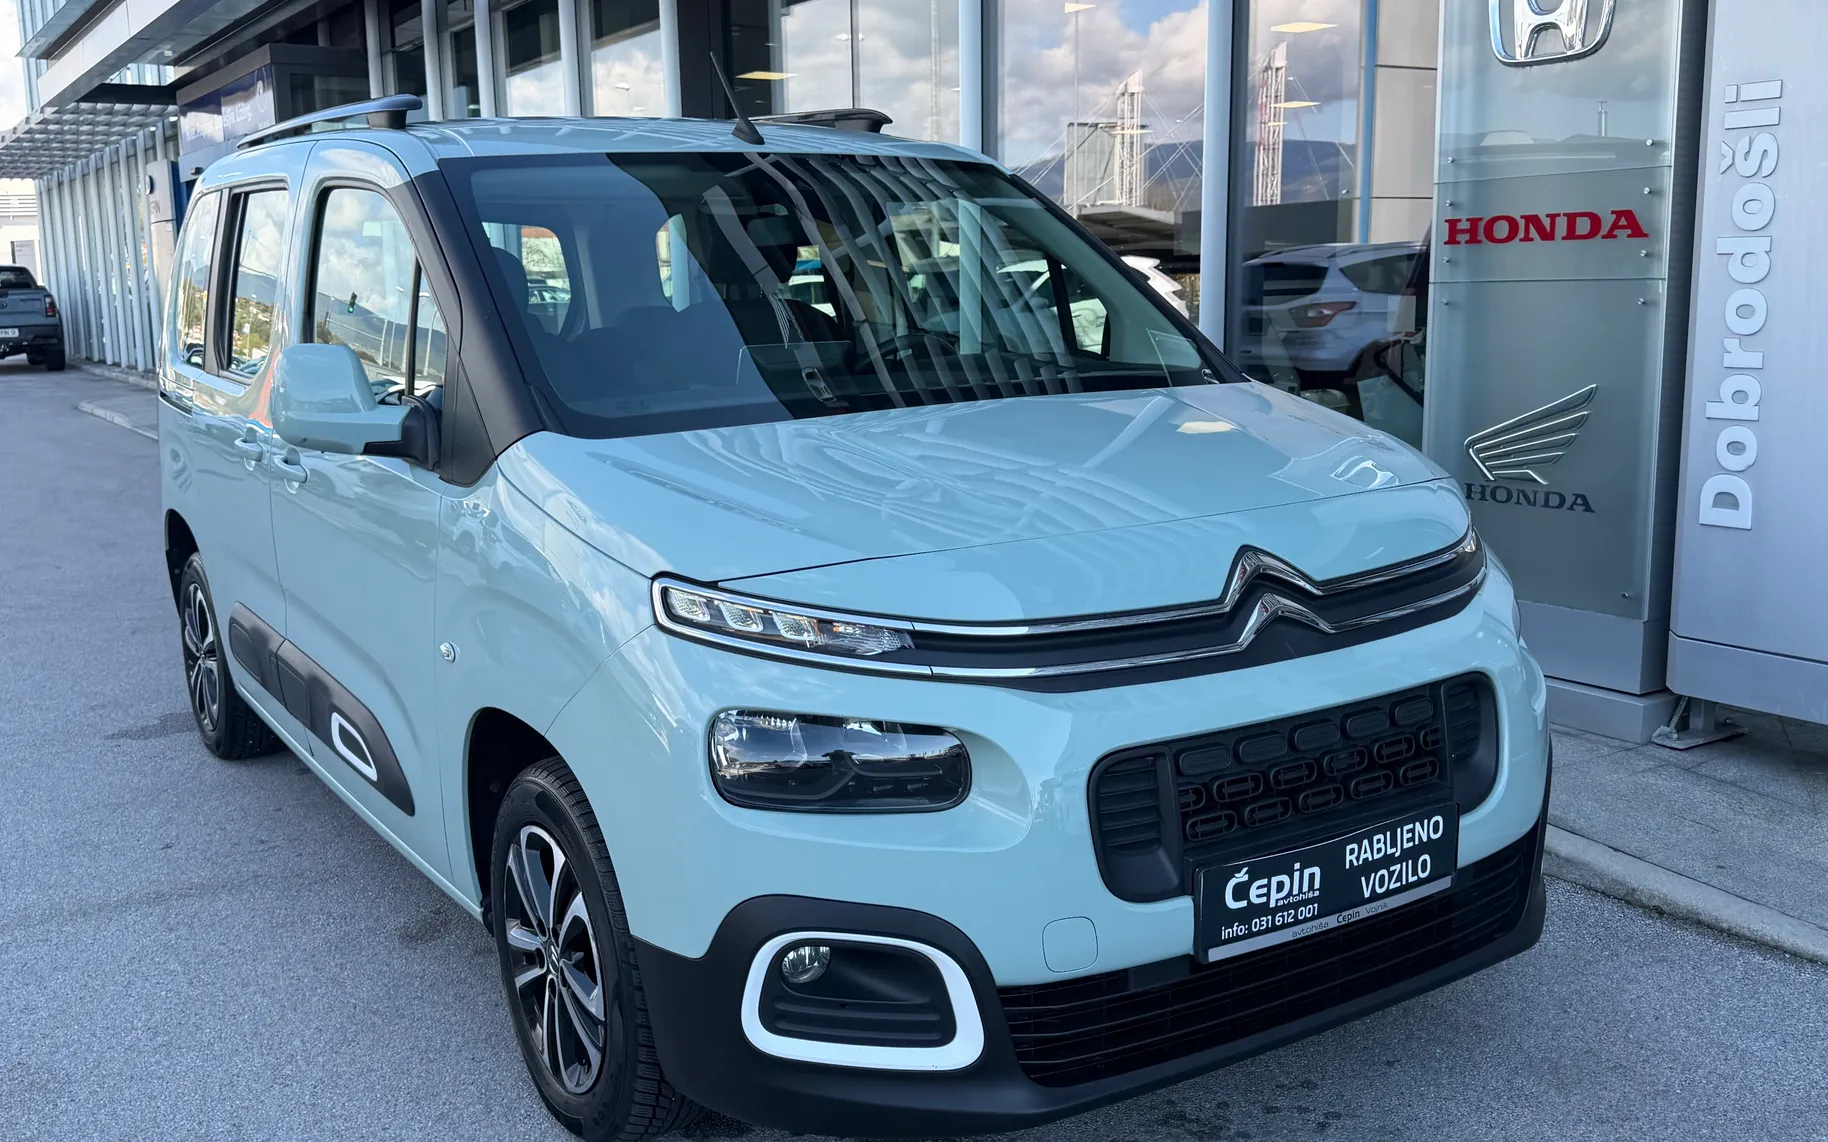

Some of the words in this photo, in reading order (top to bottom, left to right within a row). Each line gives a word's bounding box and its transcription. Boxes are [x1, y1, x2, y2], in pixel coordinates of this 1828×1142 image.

[1444, 209, 1649, 244] HONDA
[1698, 79, 1783, 530] Dobrodošli
[1464, 482, 1596, 513] HONDA
[1345, 815, 1444, 869] RABLJENO
[1224, 862, 1321, 909] Čepin
[1361, 854, 1432, 899] VOZILO
[1277, 890, 1320, 906] avtohiša
[1365, 901, 1389, 915] Vojnik
[1221, 923, 1249, 940] info:
[1251, 913, 1273, 932] 031
[1275, 908, 1296, 926] 612
[1297, 903, 1319, 922] 001
